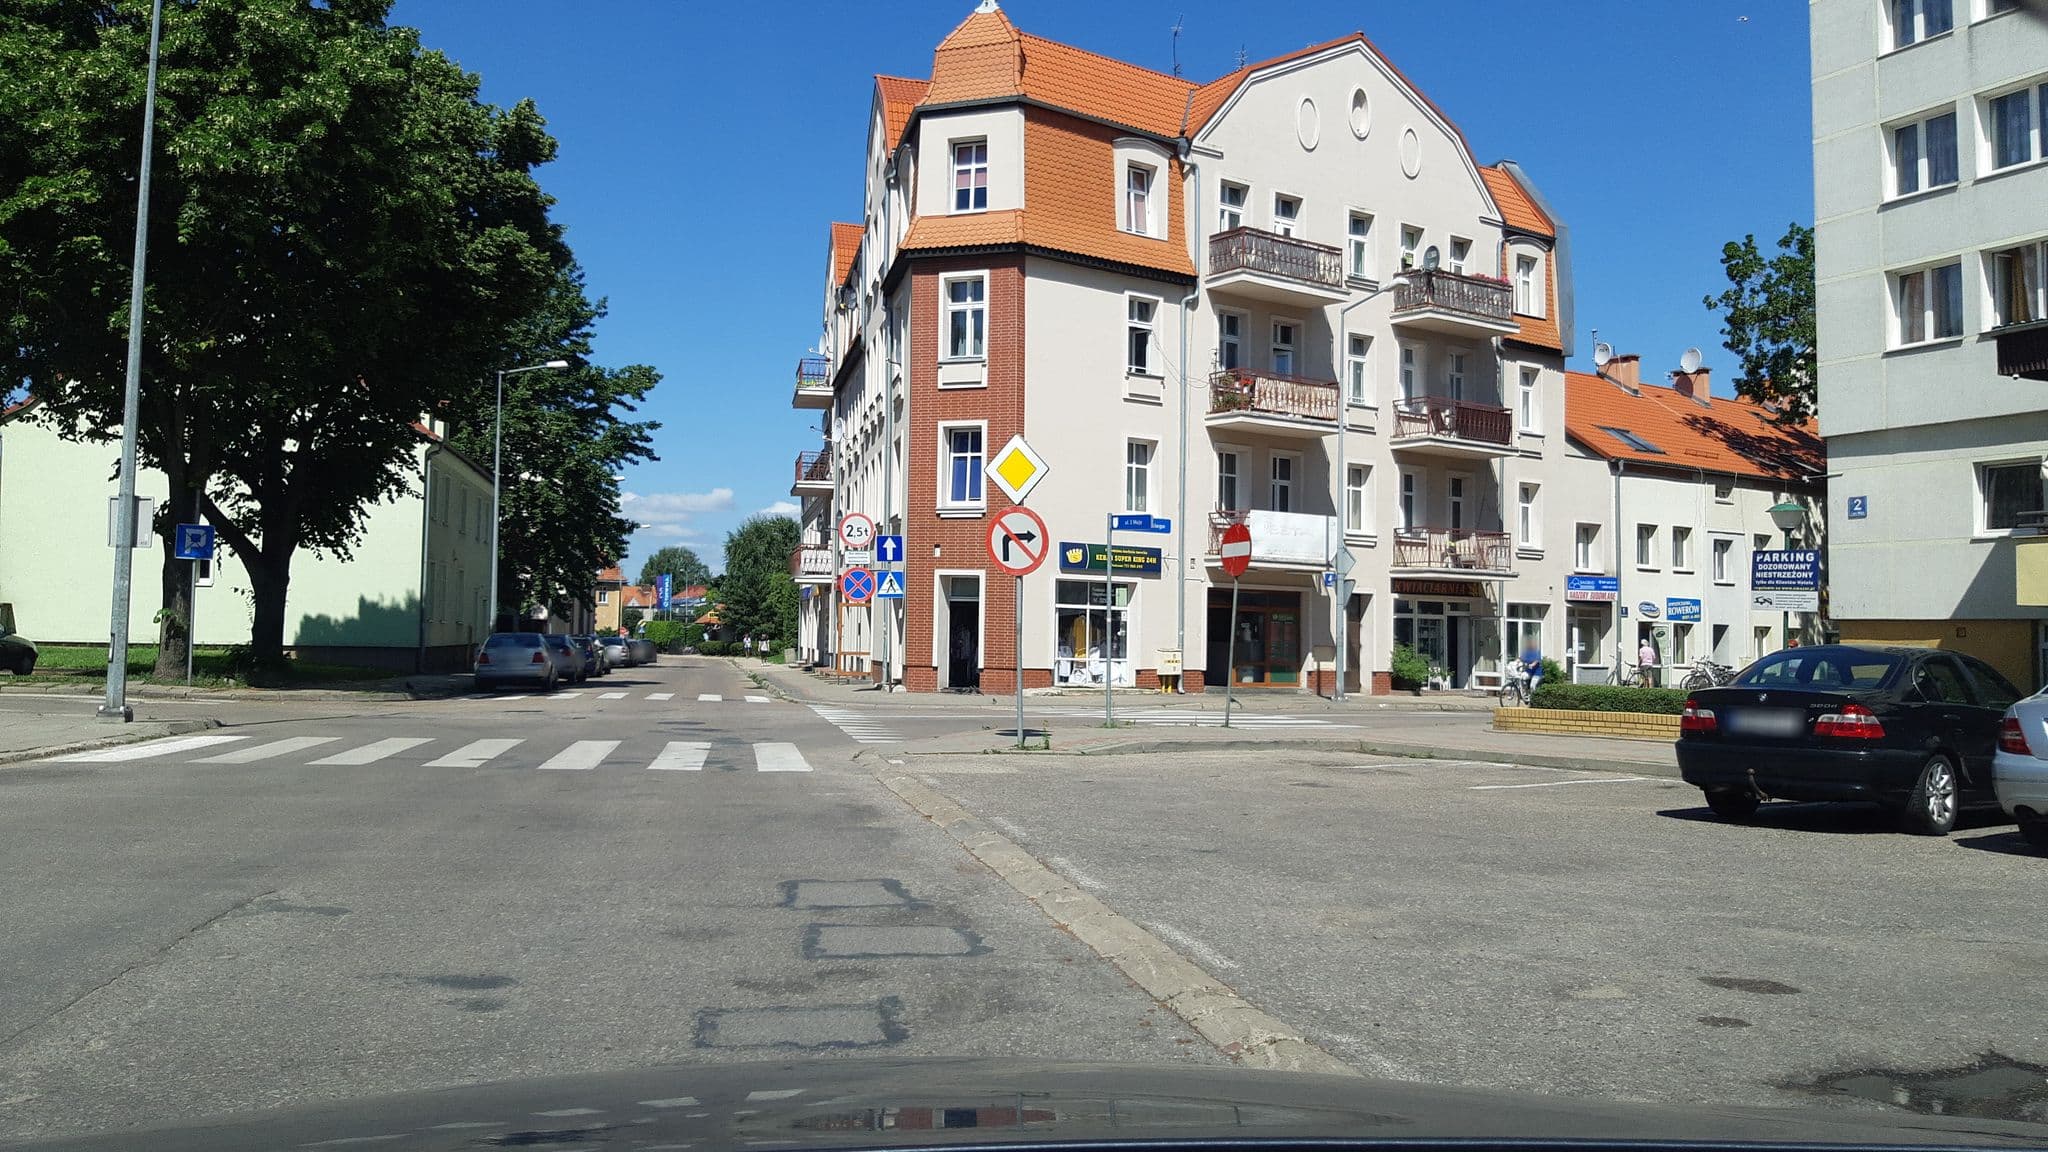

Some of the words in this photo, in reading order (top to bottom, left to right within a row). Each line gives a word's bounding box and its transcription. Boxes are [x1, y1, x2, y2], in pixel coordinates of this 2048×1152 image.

[1854, 499, 1862, 510] 2
[1756, 552, 1815, 563] PARKING
[1668, 604, 1699, 616] ROWERÓW
